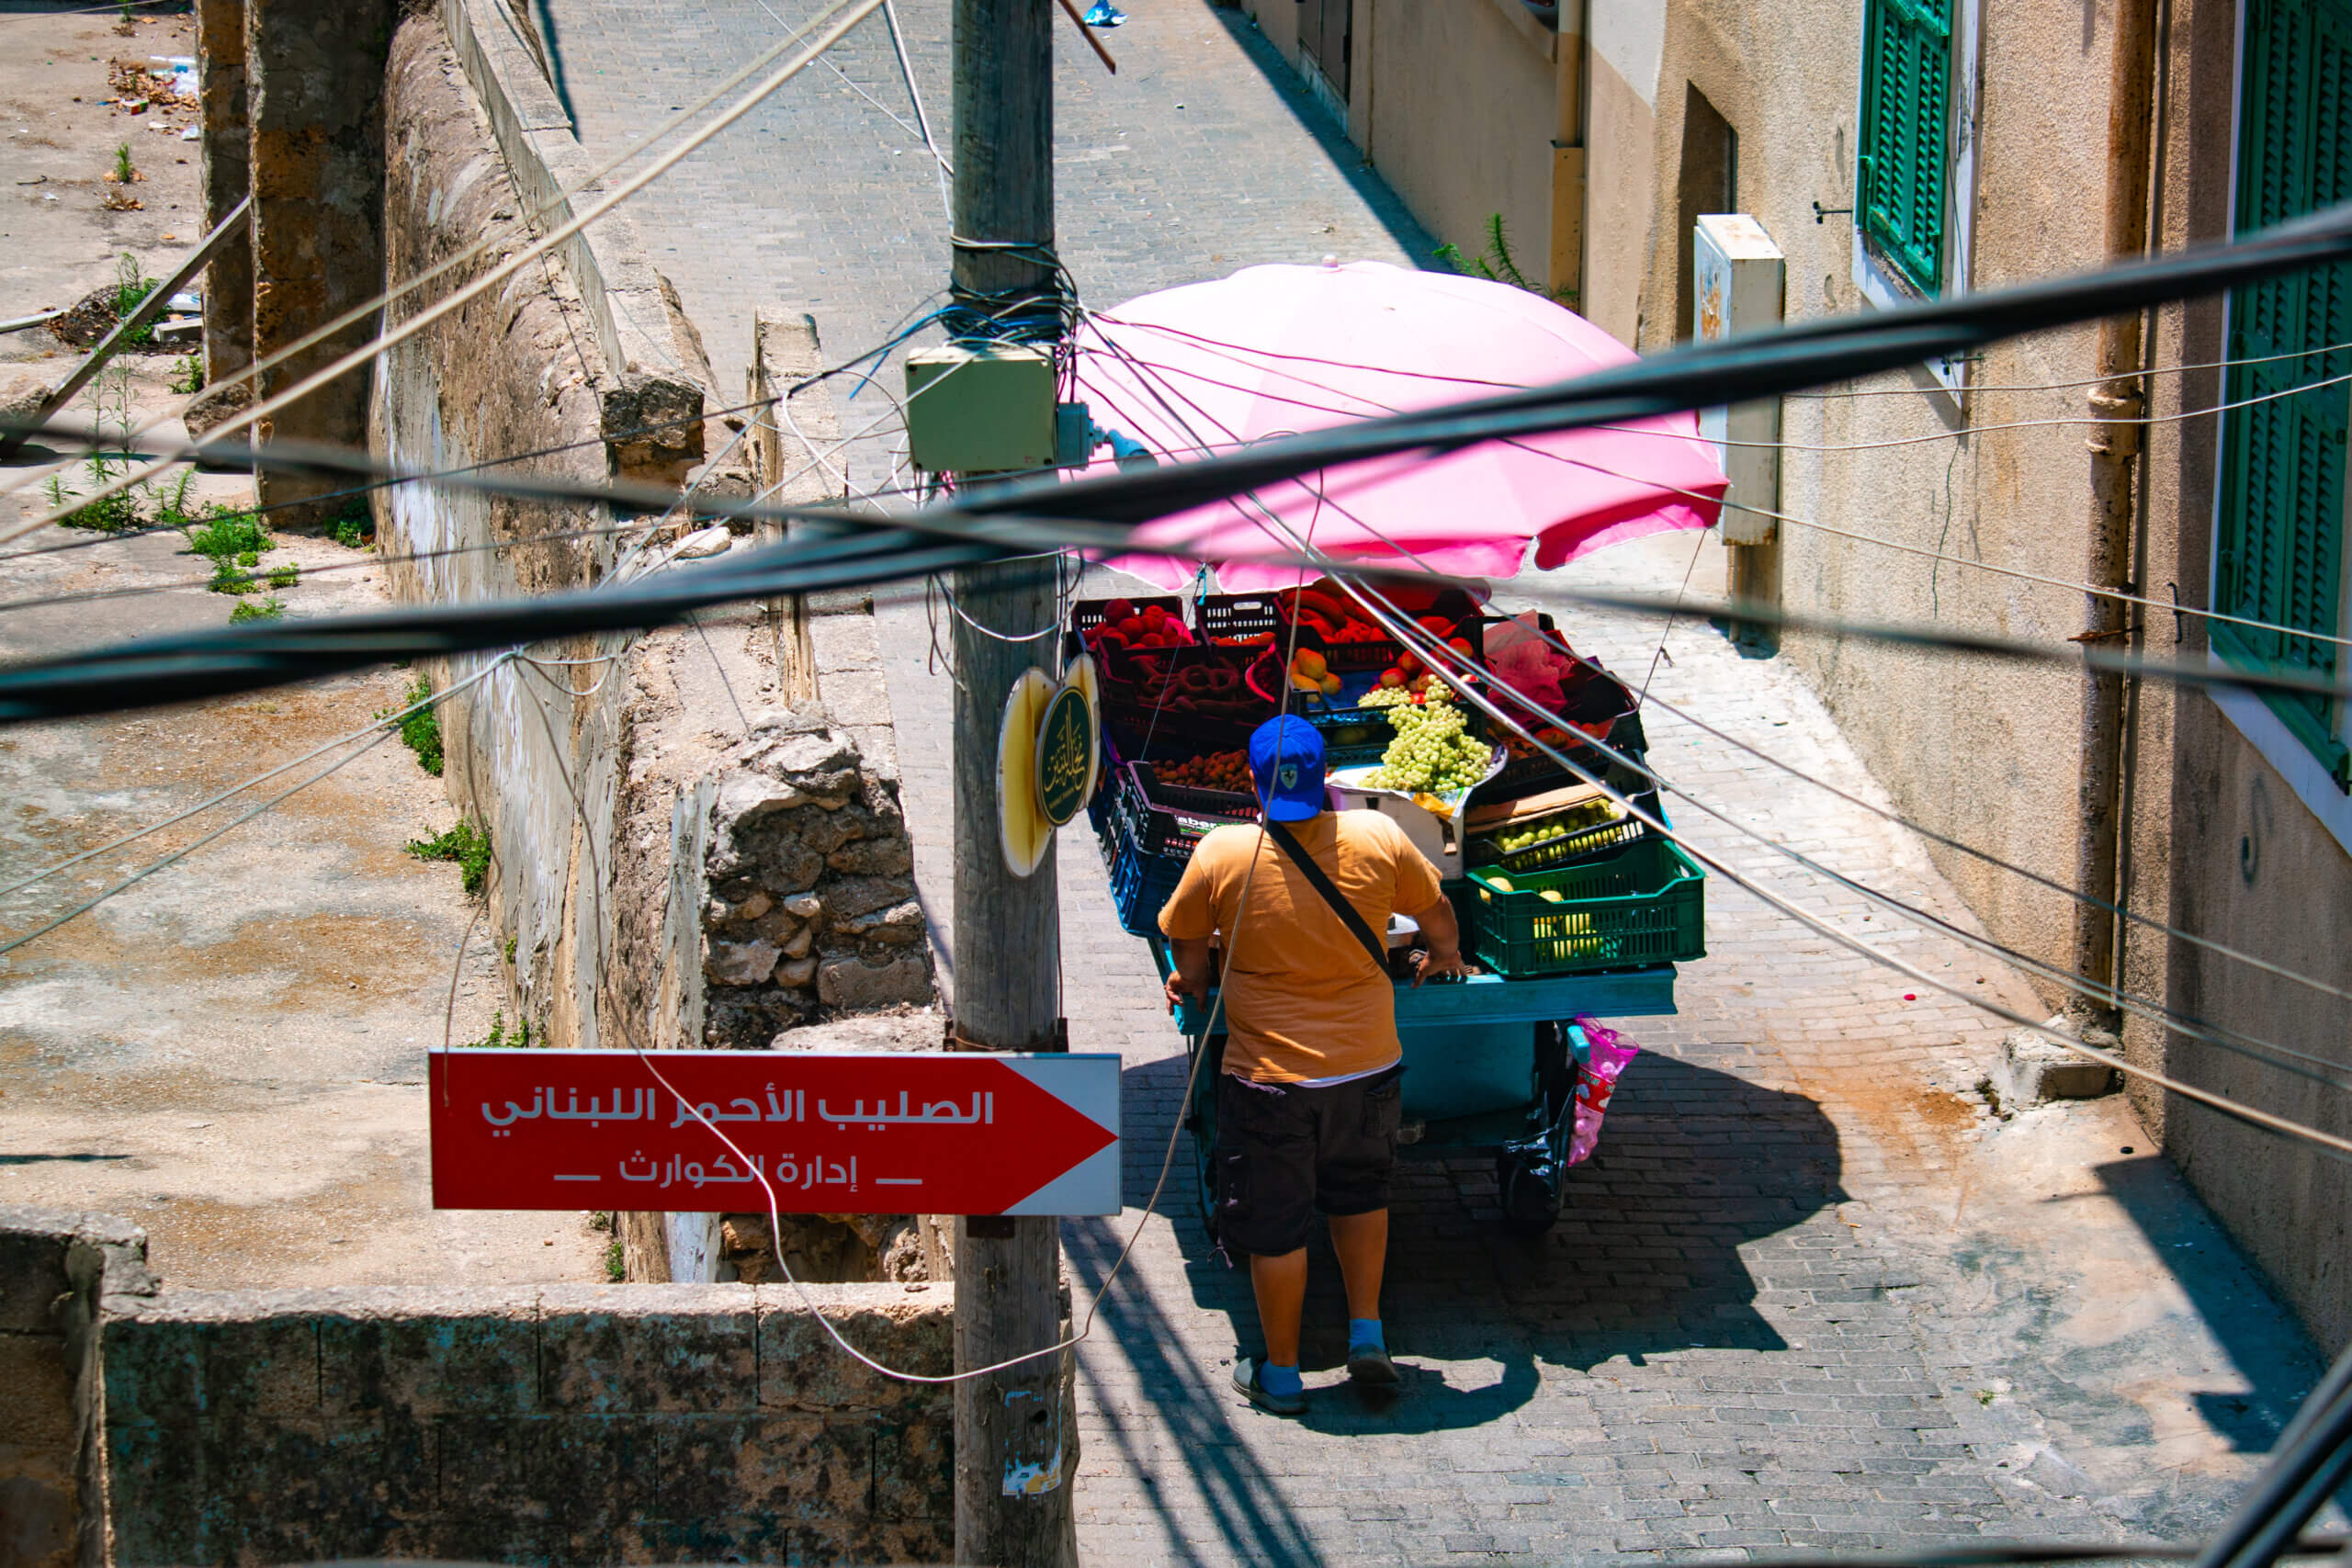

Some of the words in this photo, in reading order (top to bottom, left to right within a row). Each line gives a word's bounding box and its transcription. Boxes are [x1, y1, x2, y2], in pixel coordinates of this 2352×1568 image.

[1175, 815, 1217, 830] aber
[481, 1087, 655, 1137] اللبناني
[670, 1082, 805, 1129] الأحمر
[818, 1090, 993, 1131] الصليب
[619, 1150, 764, 1189] الكوارث
[776, 1153, 858, 1192] إدارة
